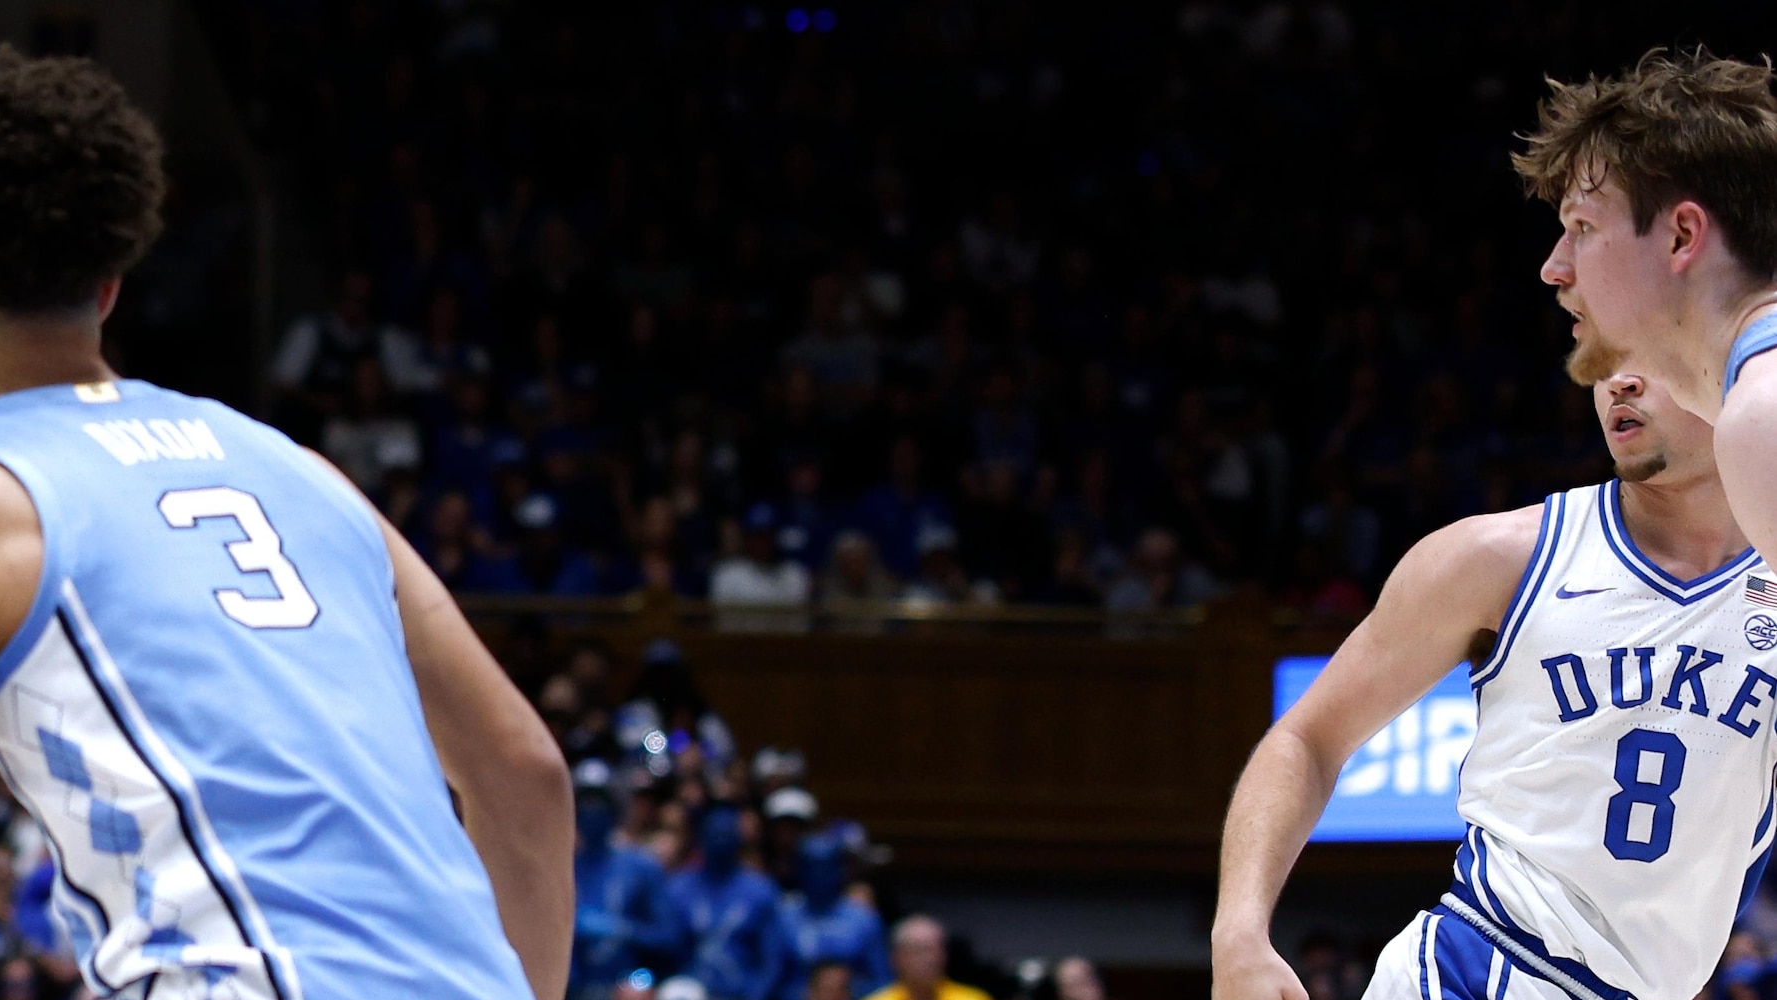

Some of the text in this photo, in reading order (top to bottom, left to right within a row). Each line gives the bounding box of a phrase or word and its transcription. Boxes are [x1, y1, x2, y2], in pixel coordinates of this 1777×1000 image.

[157, 486, 320, 629] 3
[1541, 644, 1777, 739] DUKE
[1603, 728, 1687, 863] 8
